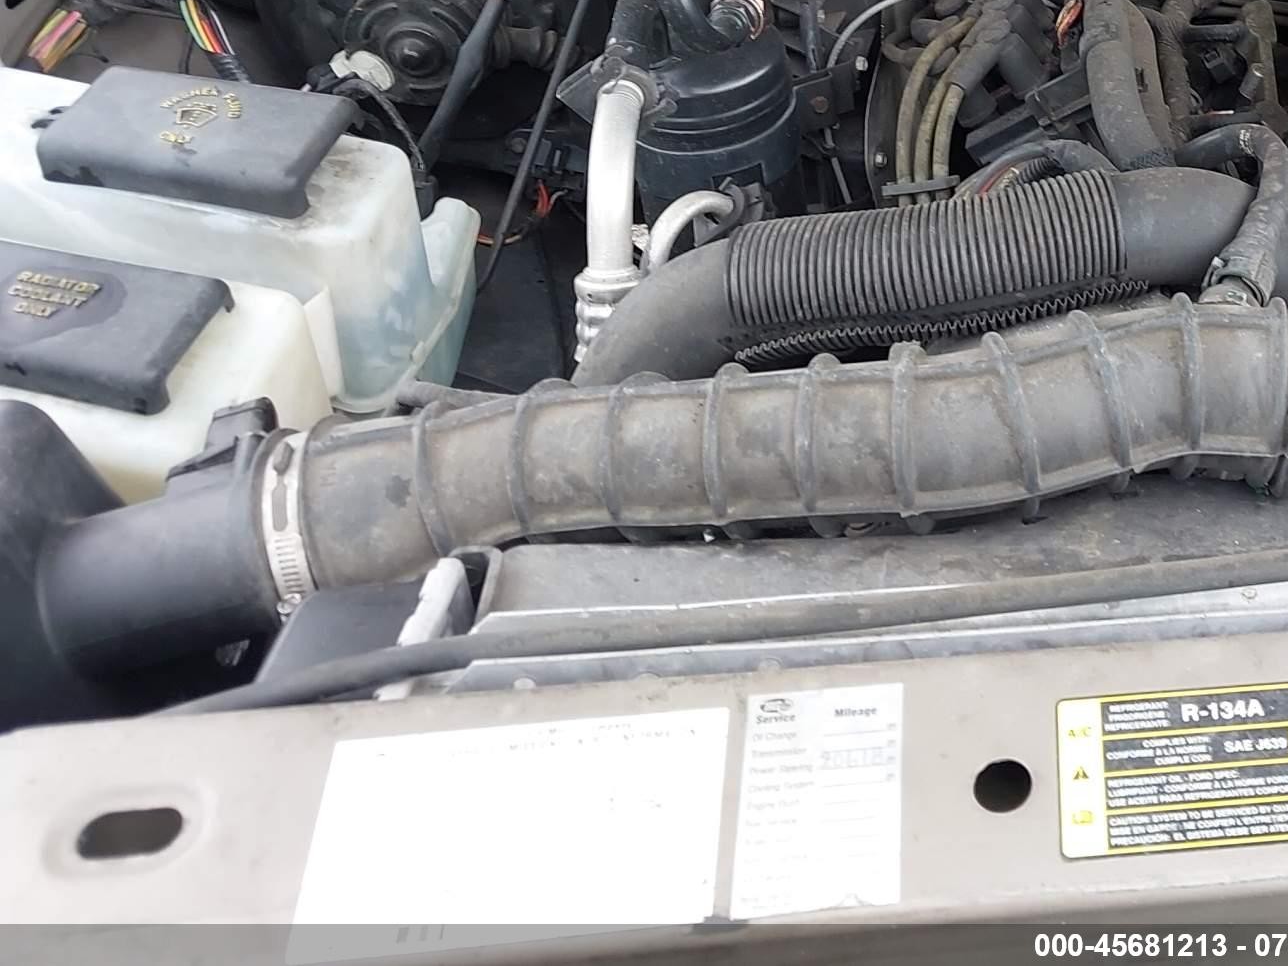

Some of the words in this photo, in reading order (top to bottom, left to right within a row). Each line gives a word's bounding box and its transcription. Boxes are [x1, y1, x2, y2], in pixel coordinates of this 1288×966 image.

[16, 271, 101, 293] RADIATOR
[8, 286, 88, 308] COOLANT
[14, 302, 58, 319] ONLY
[834, 707, 878, 718] Mileage
[1180, 698, 1265, 722] R-134A
[756, 714, 796, 724] Service
[1223, 739, 1253, 753] SAE
[1254, 736, 1287, 751] J639
